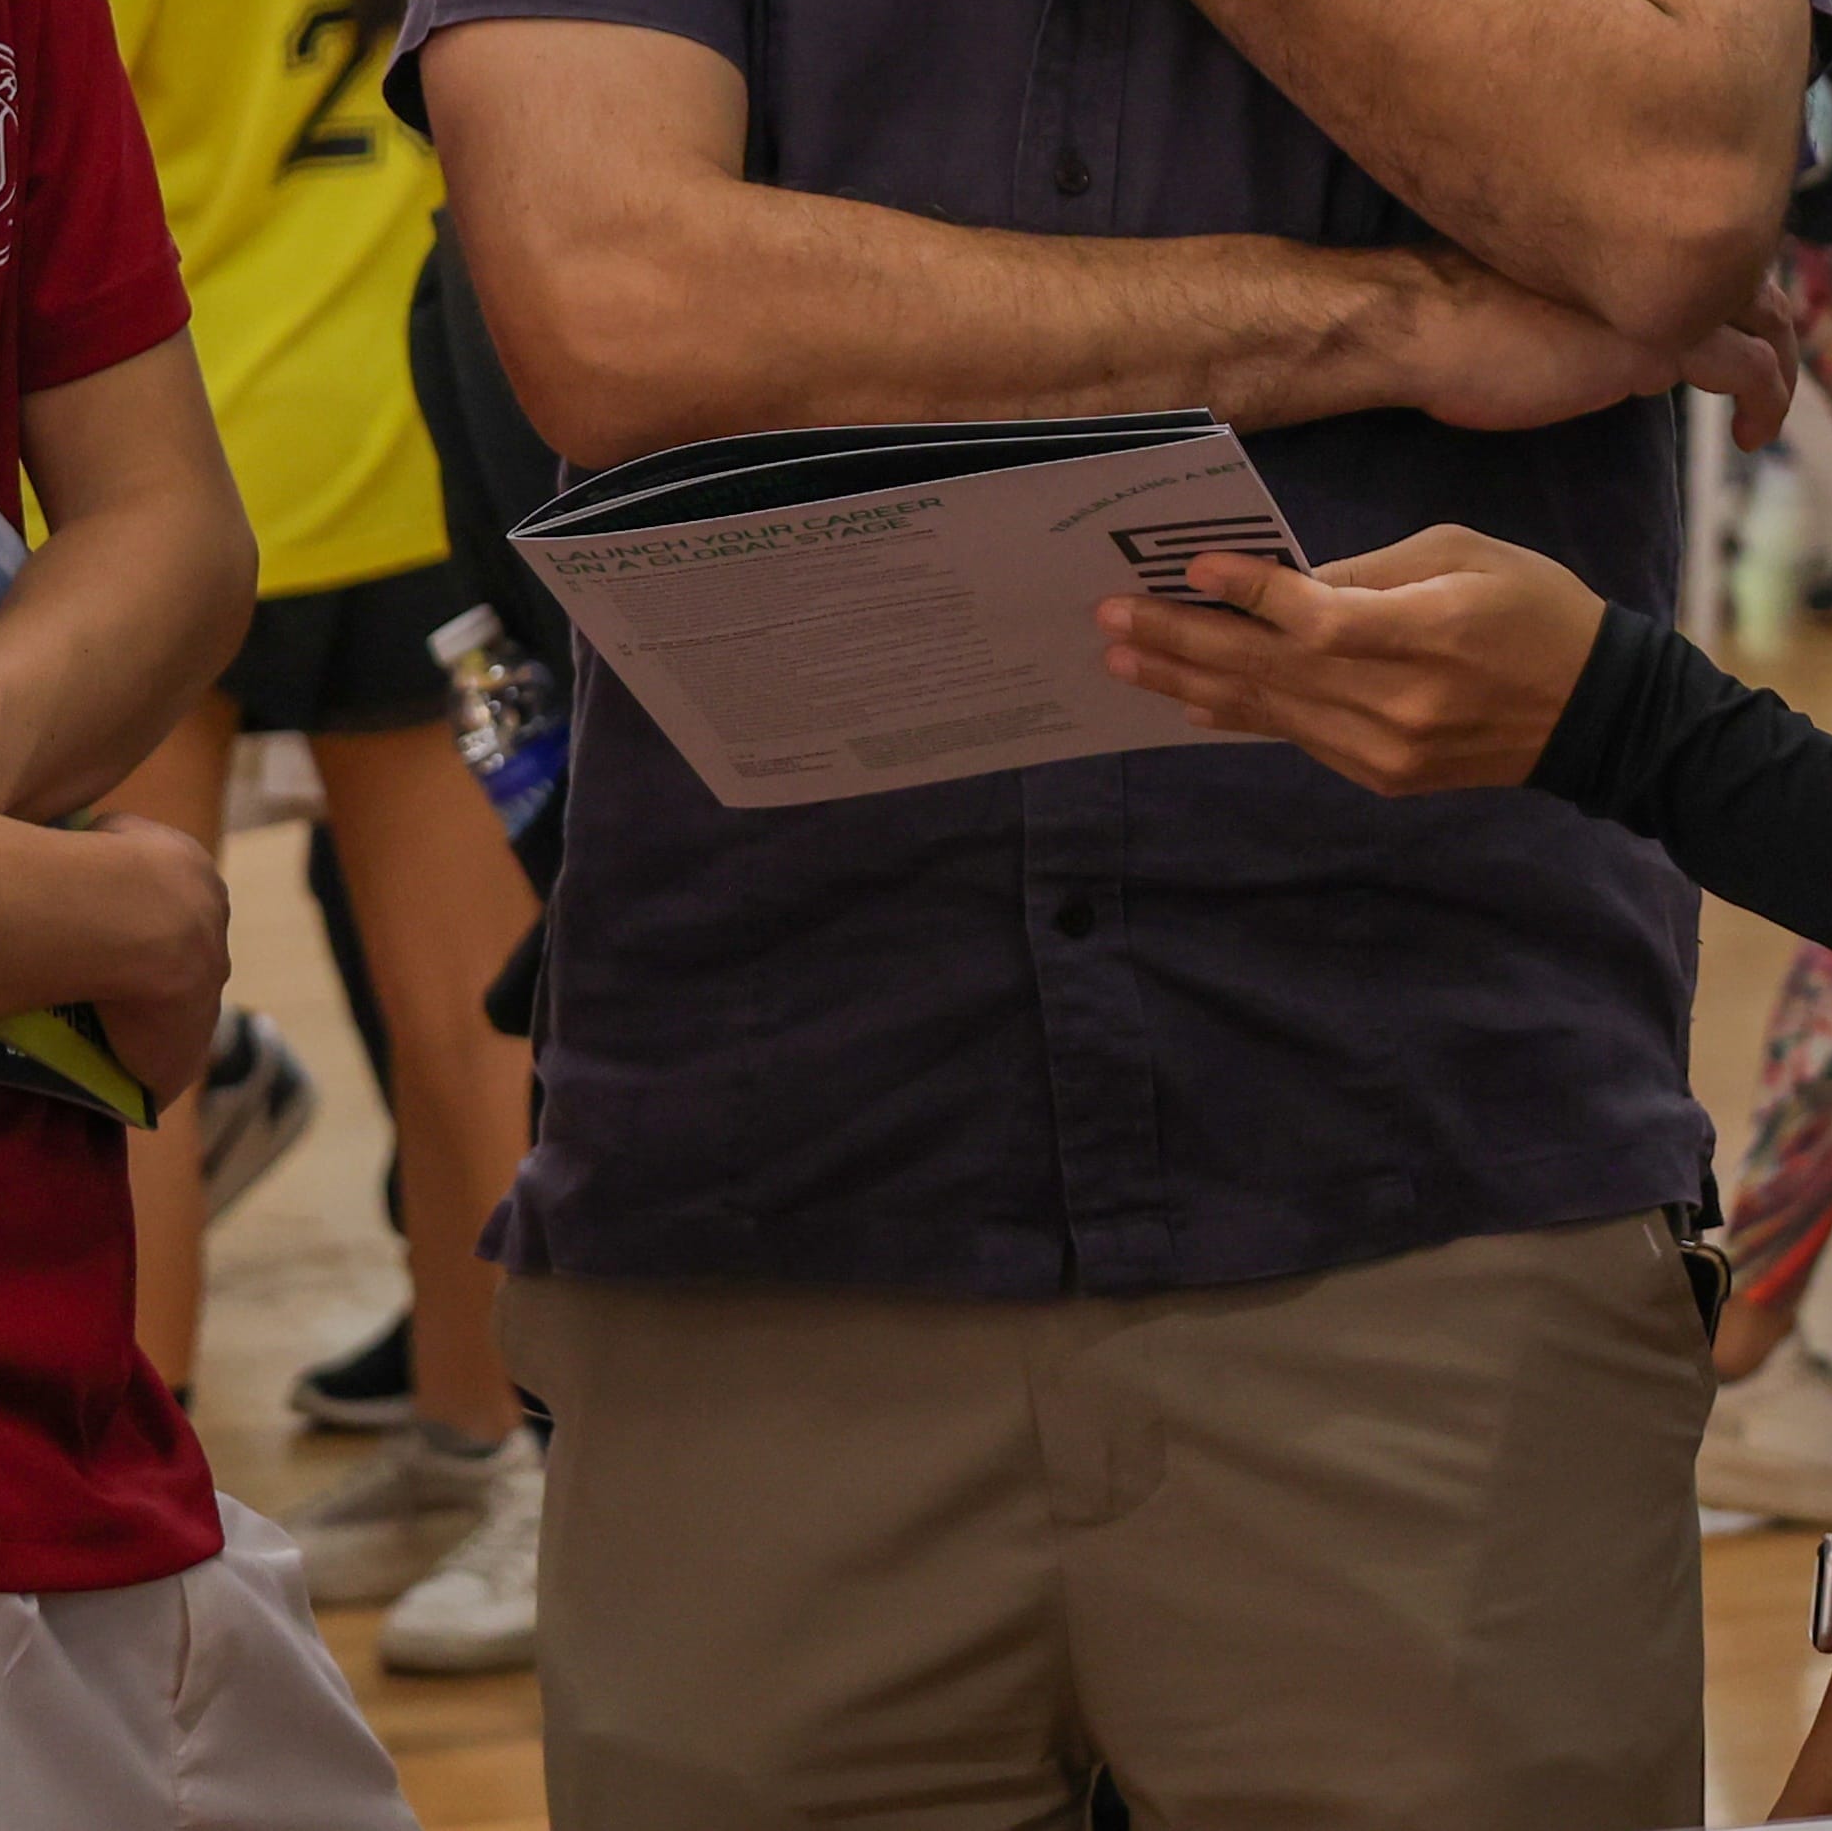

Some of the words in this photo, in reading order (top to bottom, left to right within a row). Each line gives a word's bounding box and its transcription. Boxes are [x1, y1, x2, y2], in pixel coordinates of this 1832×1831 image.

[544, 535, 688, 568] LAUNCH
[692, 521, 793, 548] YOUR
[800, 494, 945, 530] CAREER
[554, 557, 606, 579] ON
[616, 555, 642, 571] A
[647, 535, 791, 567] GLOBAL
[792, 514, 914, 546] STAGE
